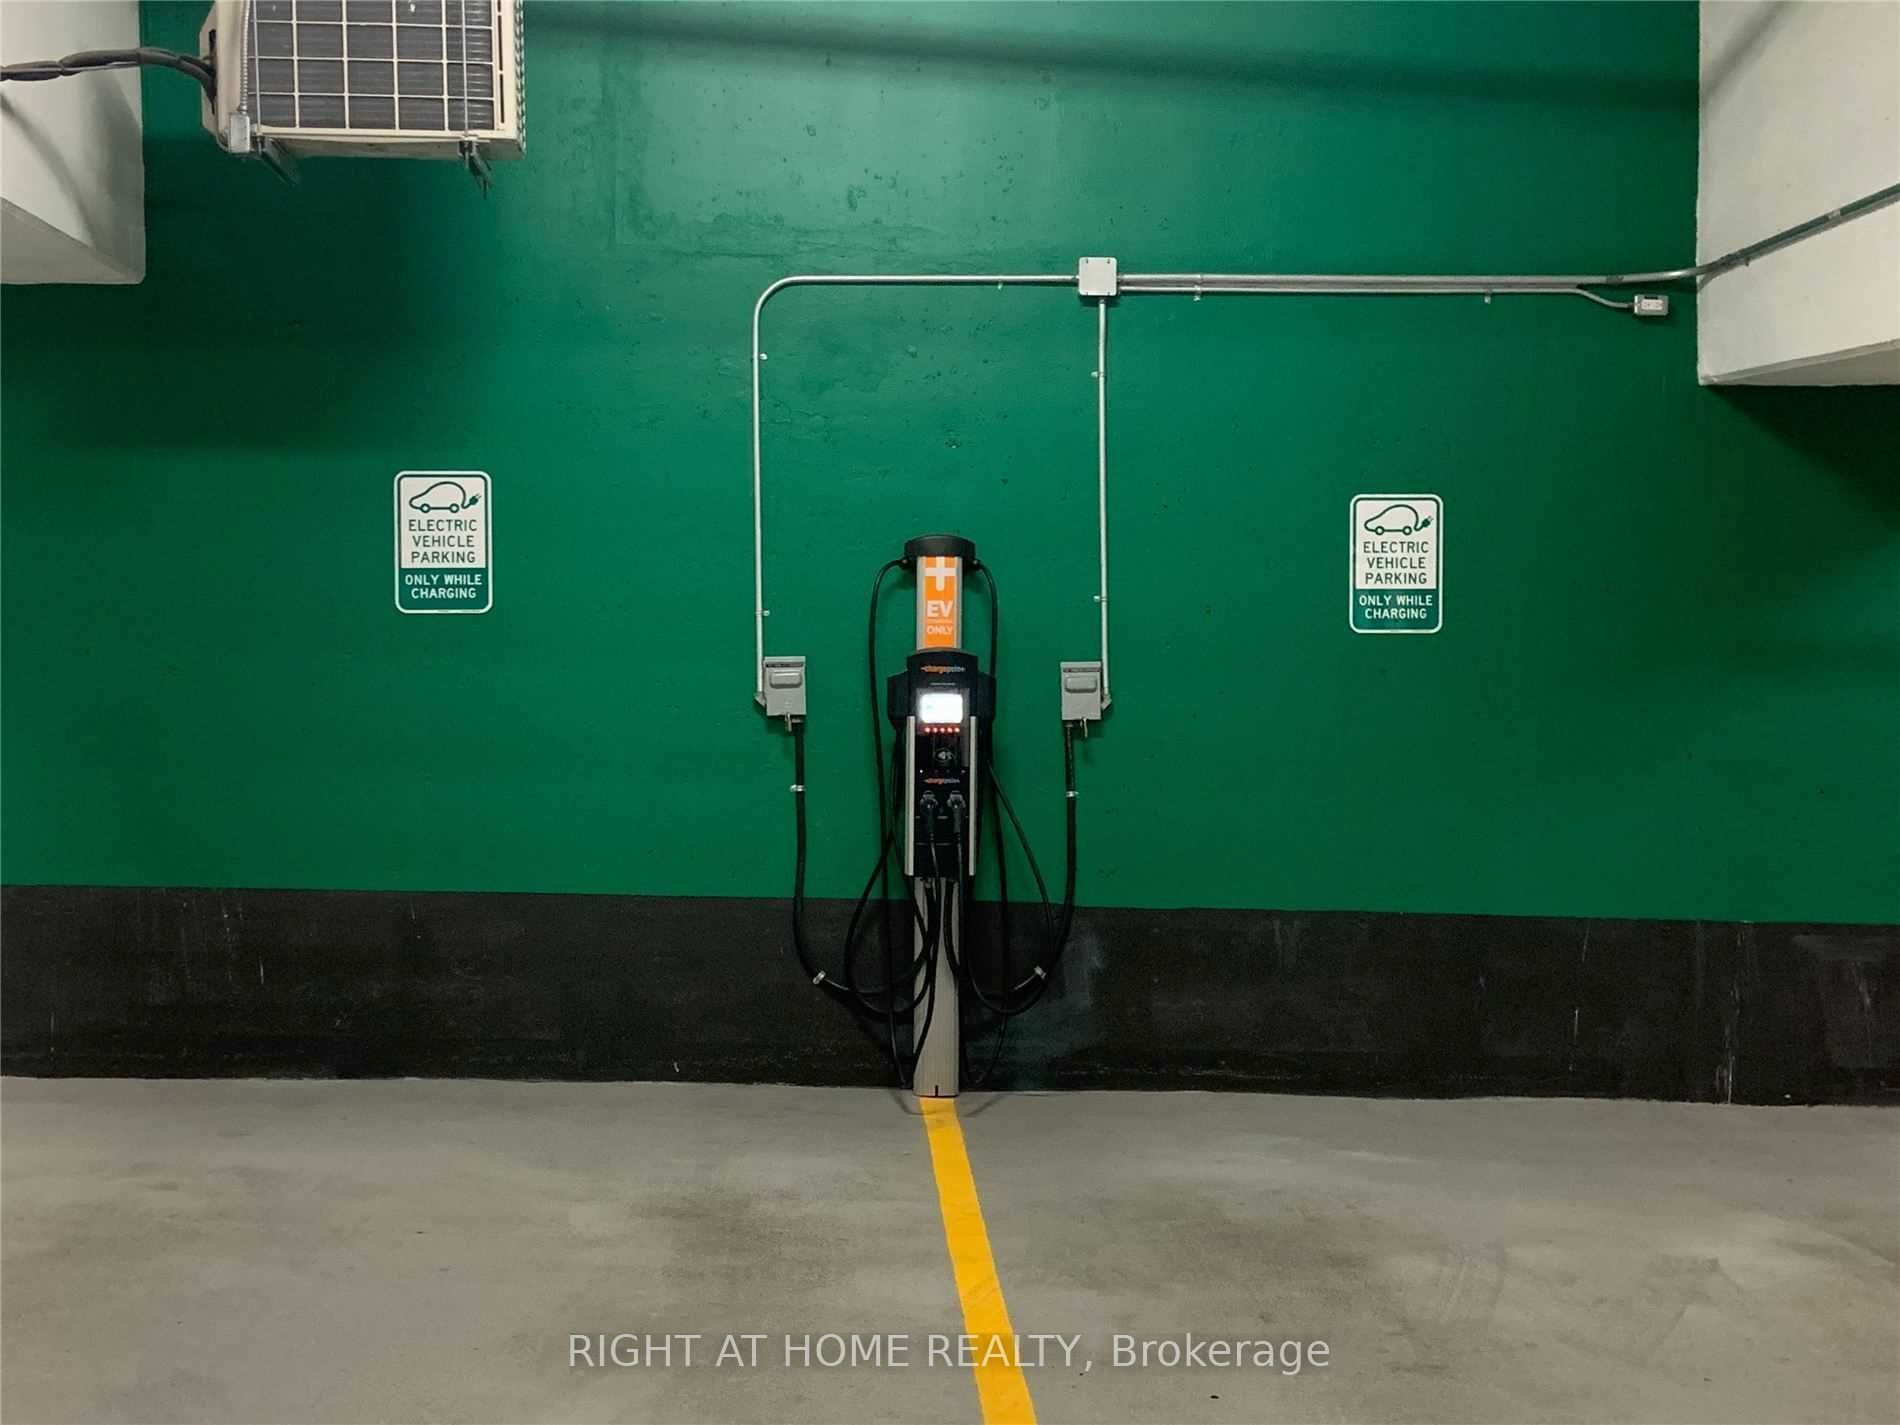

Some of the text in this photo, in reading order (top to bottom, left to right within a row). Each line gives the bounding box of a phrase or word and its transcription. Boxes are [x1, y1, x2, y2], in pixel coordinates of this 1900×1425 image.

[408, 519, 477, 532] ELECTRIC
[412, 535, 475, 547] VEHICLE
[1363, 541, 1429, 553] ELECTRIC
[411, 551, 476, 563] PARKING
[1366, 557, 1426, 569] VEHICLE
[405, 574, 482, 585] ONLY WHILE
[1365, 572, 1427, 584] PARKING
[411, 588, 476, 599] CHARGING
[1359, 595, 1433, 606] ONLY WHILE
[927, 600, 953, 617] EV
[1365, 608, 1427, 619] CHARGING
